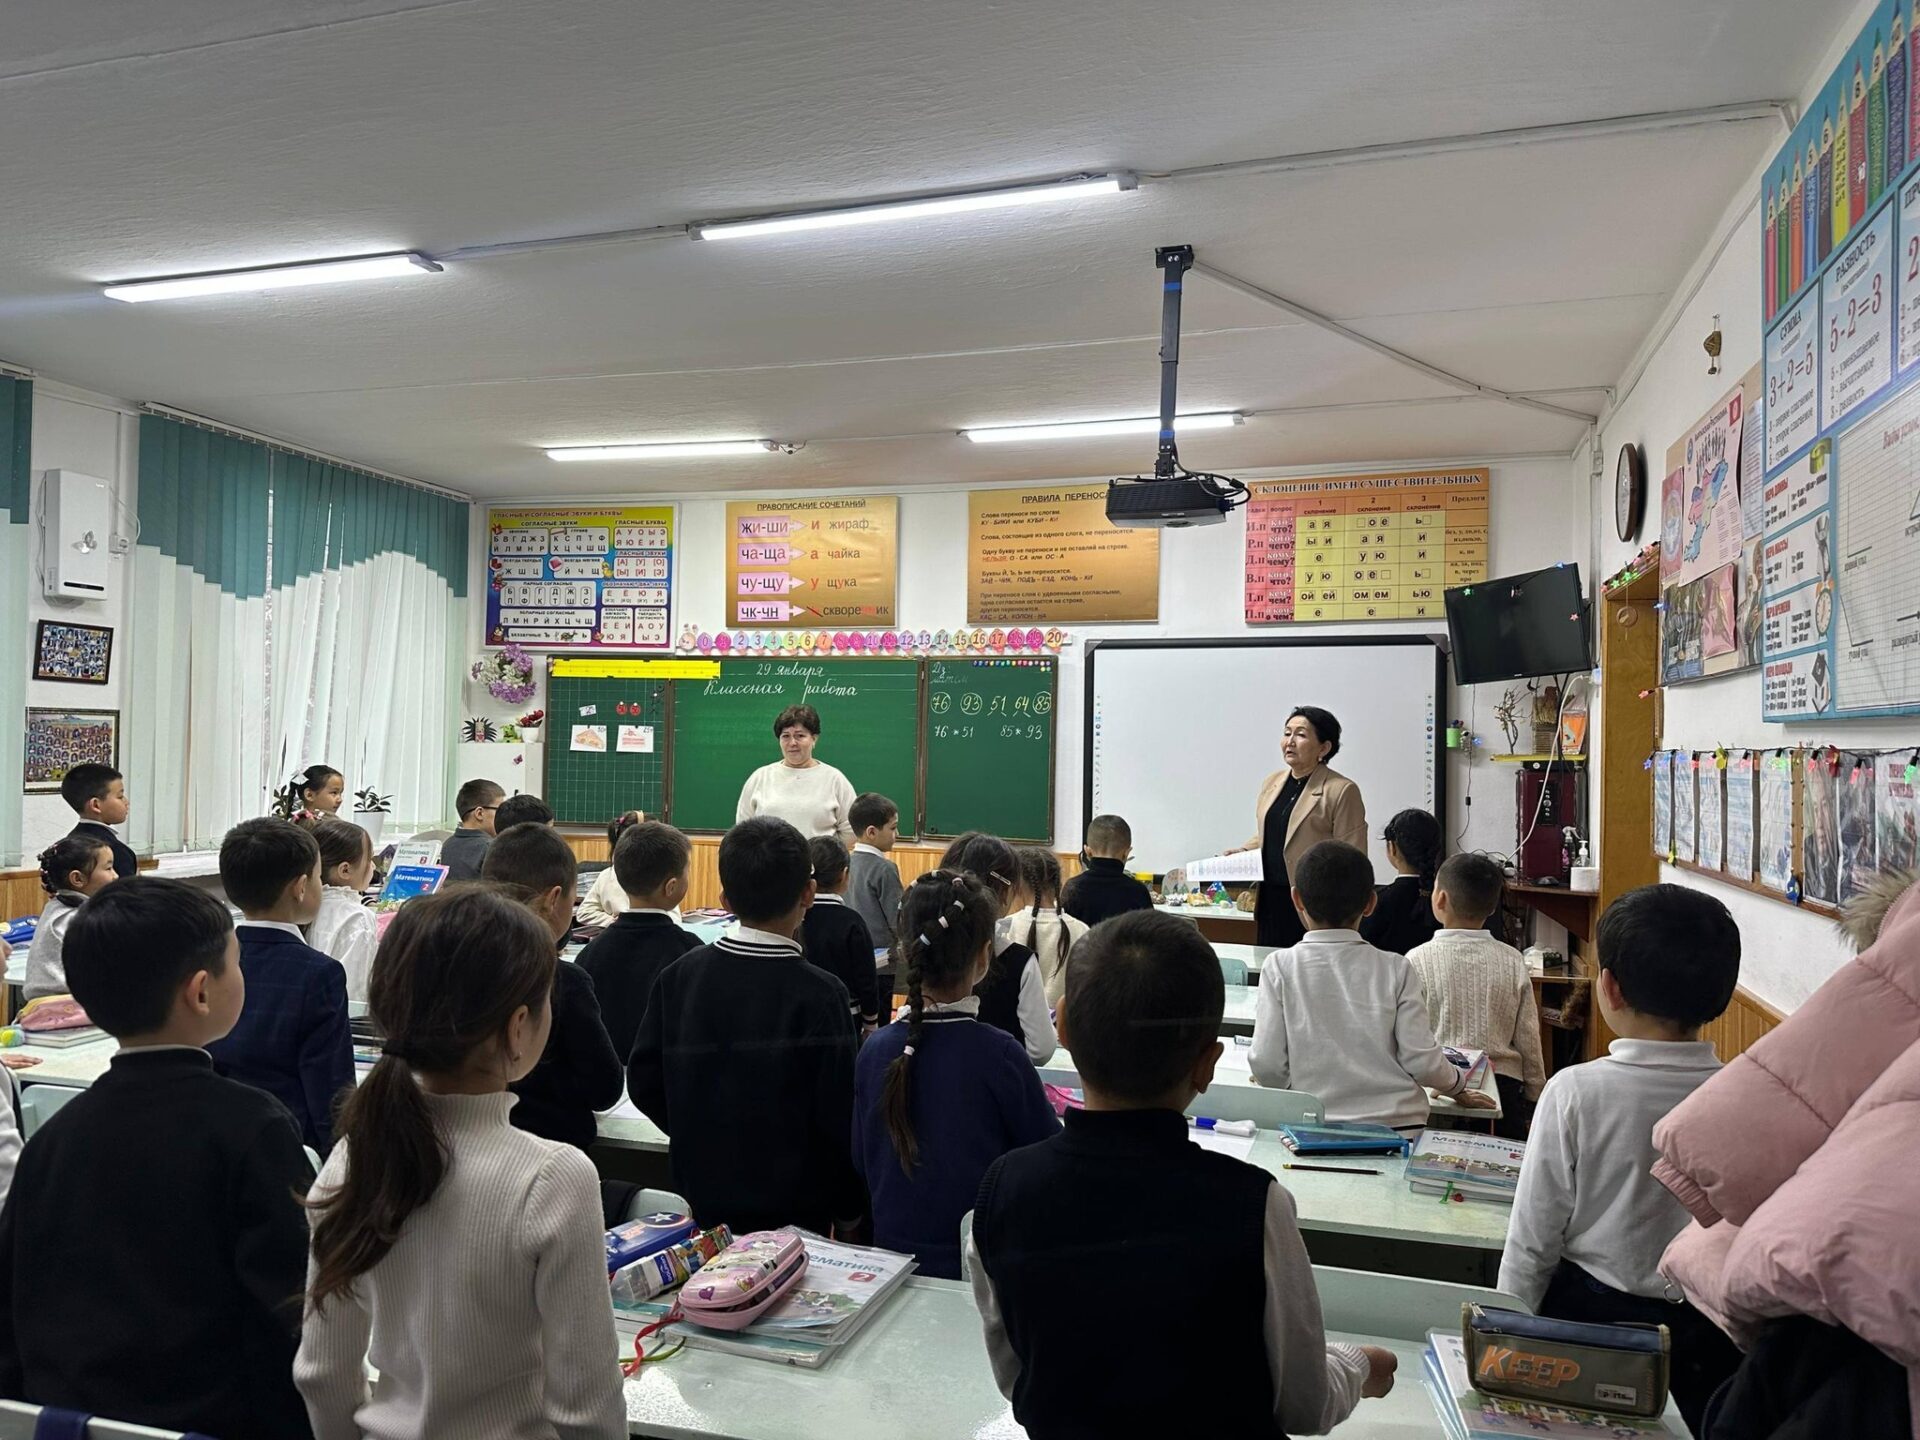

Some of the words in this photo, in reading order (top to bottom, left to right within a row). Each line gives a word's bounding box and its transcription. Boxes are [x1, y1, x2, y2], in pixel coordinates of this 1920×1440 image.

[1770, 339, 1814, 408] 3+2=5
[1255, 483, 1321, 494] СКЛОНЕНИЕ
[1360, 475, 1481, 488] СУЩЕСТВИТЕЛЬНЫХ
[757, 501, 818, 511] ПРАВОПИСАНИЕ
[820, 499, 866, 508] СОЧЕТАНИЙ
[1021, 494, 1061, 504] ПРАВИЛА
[742, 522, 788, 533] жи-ши
[829, 518, 869, 531] жираф
[1309, 521, 1315, 529] а
[742, 548, 786, 562] ча-ща
[810, 549, 819, 560] а
[828, 549, 861, 560] чайка
[1316, 554, 1322, 562] е
[742, 577, 784, 592] чу-щу
[827, 577, 857, 589] щука
[1301, 591, 1314, 600] ой
[1323, 591, 1335, 600] ей
[1354, 591, 1369, 599] ом
[1375, 591, 1389, 599] ем
[741, 606, 779, 619] чк-чн
[1315, 609, 1321, 617] е
[1368, 608, 1374, 616] е
[702, 636, 708, 646] 0
[738, 635, 744, 645] 2
[755, 635, 761, 645] 3
[771, 635, 777, 646] 4
[788, 635, 794, 646] 5
[804, 635, 811, 646] 6
[821, 635, 827, 645] 7
[868, 635, 879, 647] 10
[901, 634, 913, 645] 12
[919, 633, 930, 645] 13
[937, 633, 949, 645] 14
[955, 634, 966, 645] 15
[973, 632, 985, 644] 16
[991, 633, 1003, 644] 17
[1010, 632, 1022, 644] 18
[1029, 632, 1041, 644] 19
[1047, 631, 1060, 643] 20
[757, 663, 772, 676] 29
[774, 662, 825, 685] января
[704, 680, 785, 696] Классная
[803, 679, 858, 704] работа
[933, 695, 949, 711] 76
[963, 696, 980, 711] 93
[990, 695, 1006, 711] 51
[1015, 696, 1029, 712] 64
[1035, 696, 1050, 711] 85
[934, 726, 949, 738] 76
[962, 726, 974, 738] 51
[1000, 725, 1015, 738] 85
[1025, 725, 1043, 739] 93
[395, 874, 434, 882] Математика
[809, 1255, 884, 1273] ематика
[1479, 1344, 1581, 1388] KEEP
